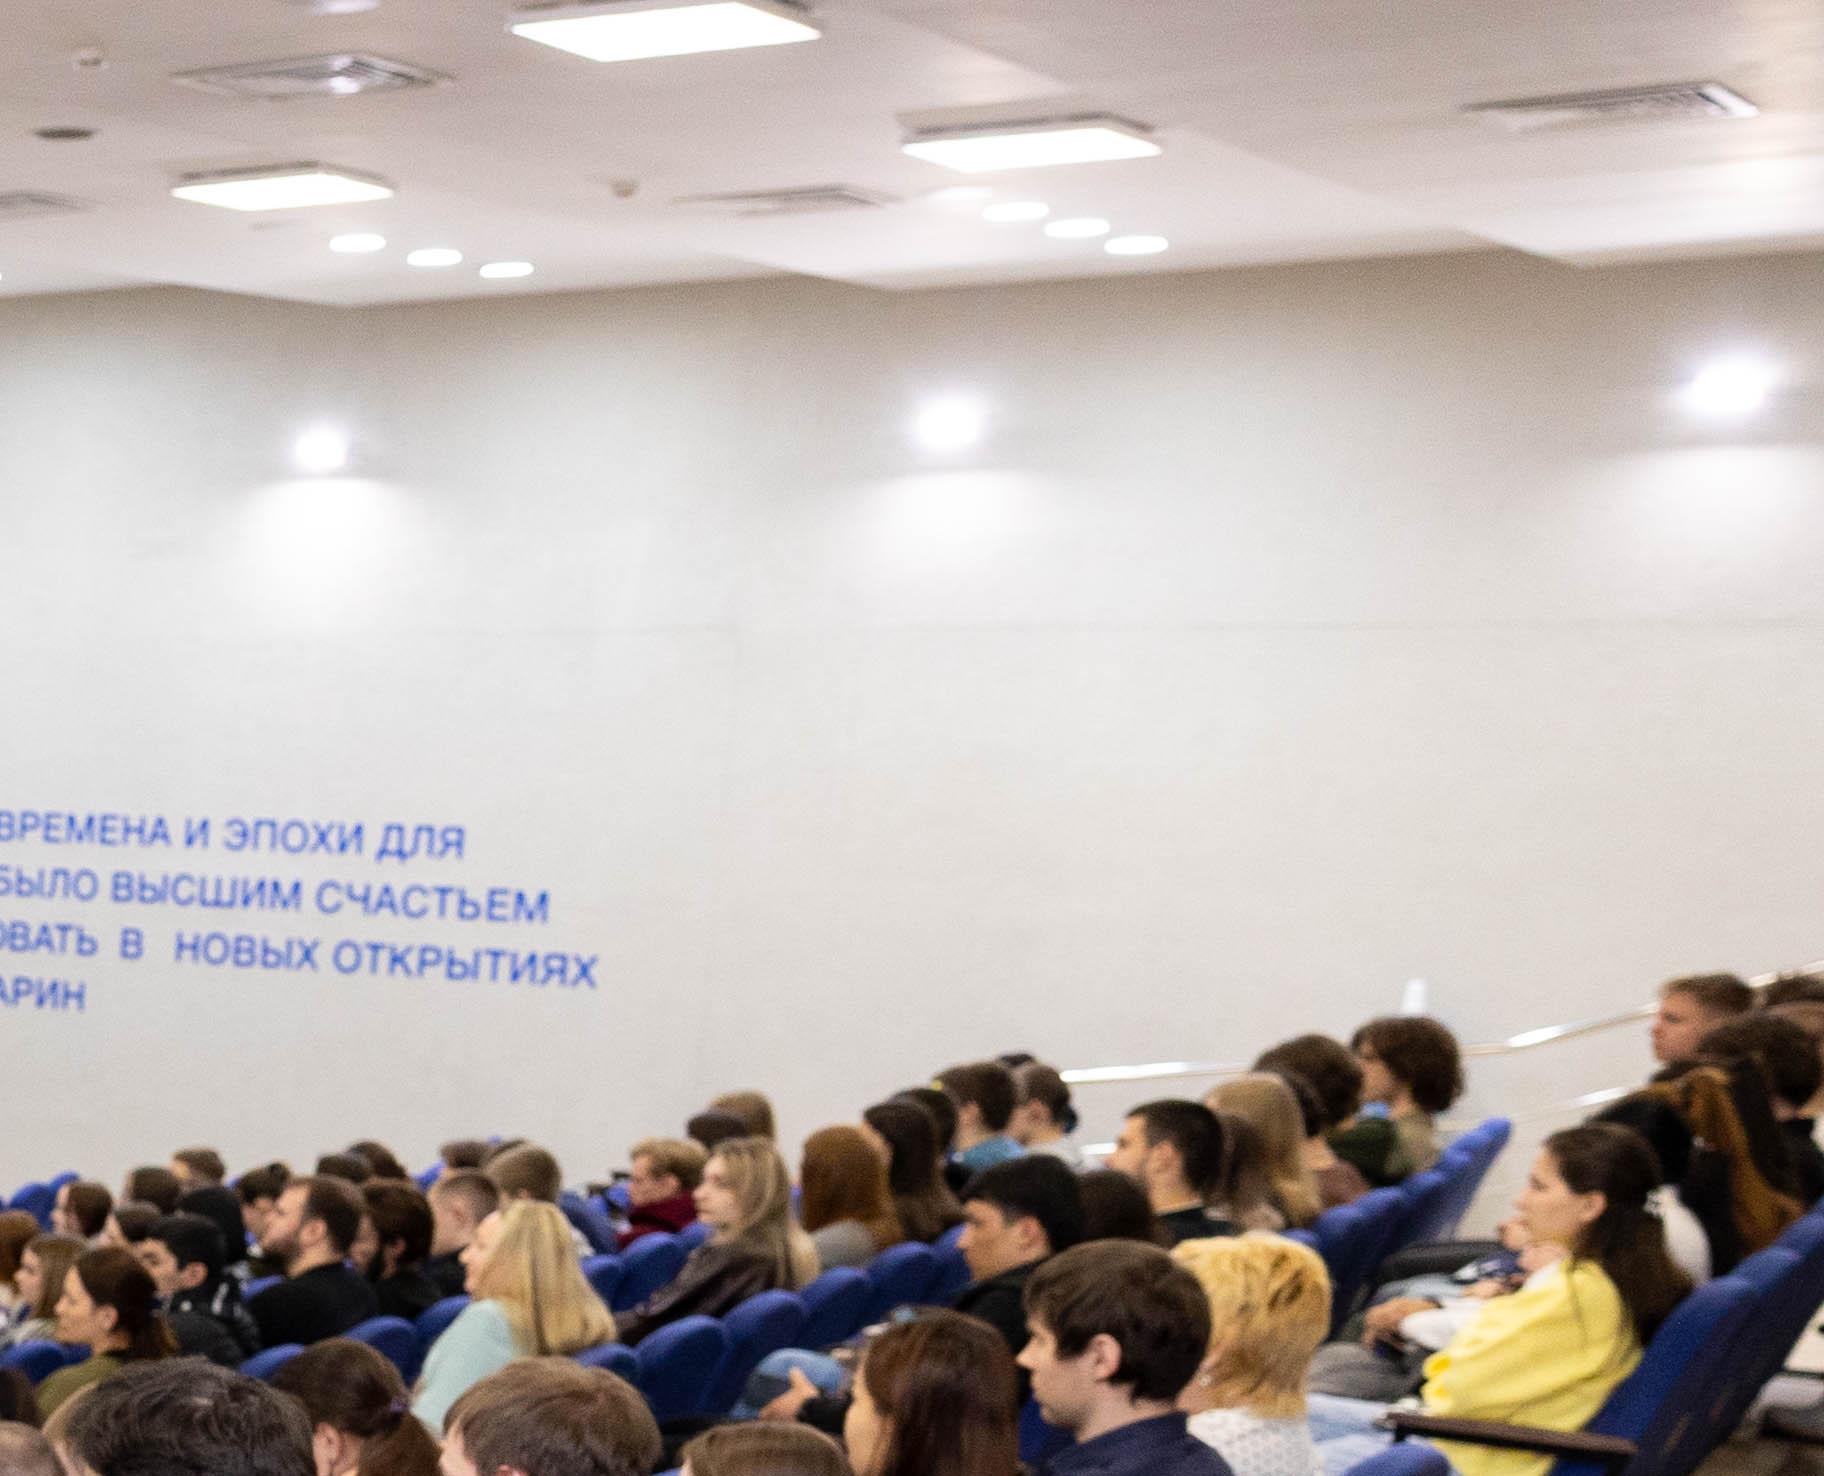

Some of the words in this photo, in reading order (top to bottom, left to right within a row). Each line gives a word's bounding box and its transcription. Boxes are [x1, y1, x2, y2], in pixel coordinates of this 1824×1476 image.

[184, 816, 211, 848] И
[223, 817, 364, 855] ЭПОХИ
[376, 822, 466, 863] ДЛЯ
[110, 868, 302, 912] ВЫСШИМ
[315, 878, 551, 925] СЧАСТЬЕМ
[119, 926, 144, 961] В
[174, 931, 320, 972] НОВЫХ
[332, 938, 598, 989] ОТКРЫТИЯХ
